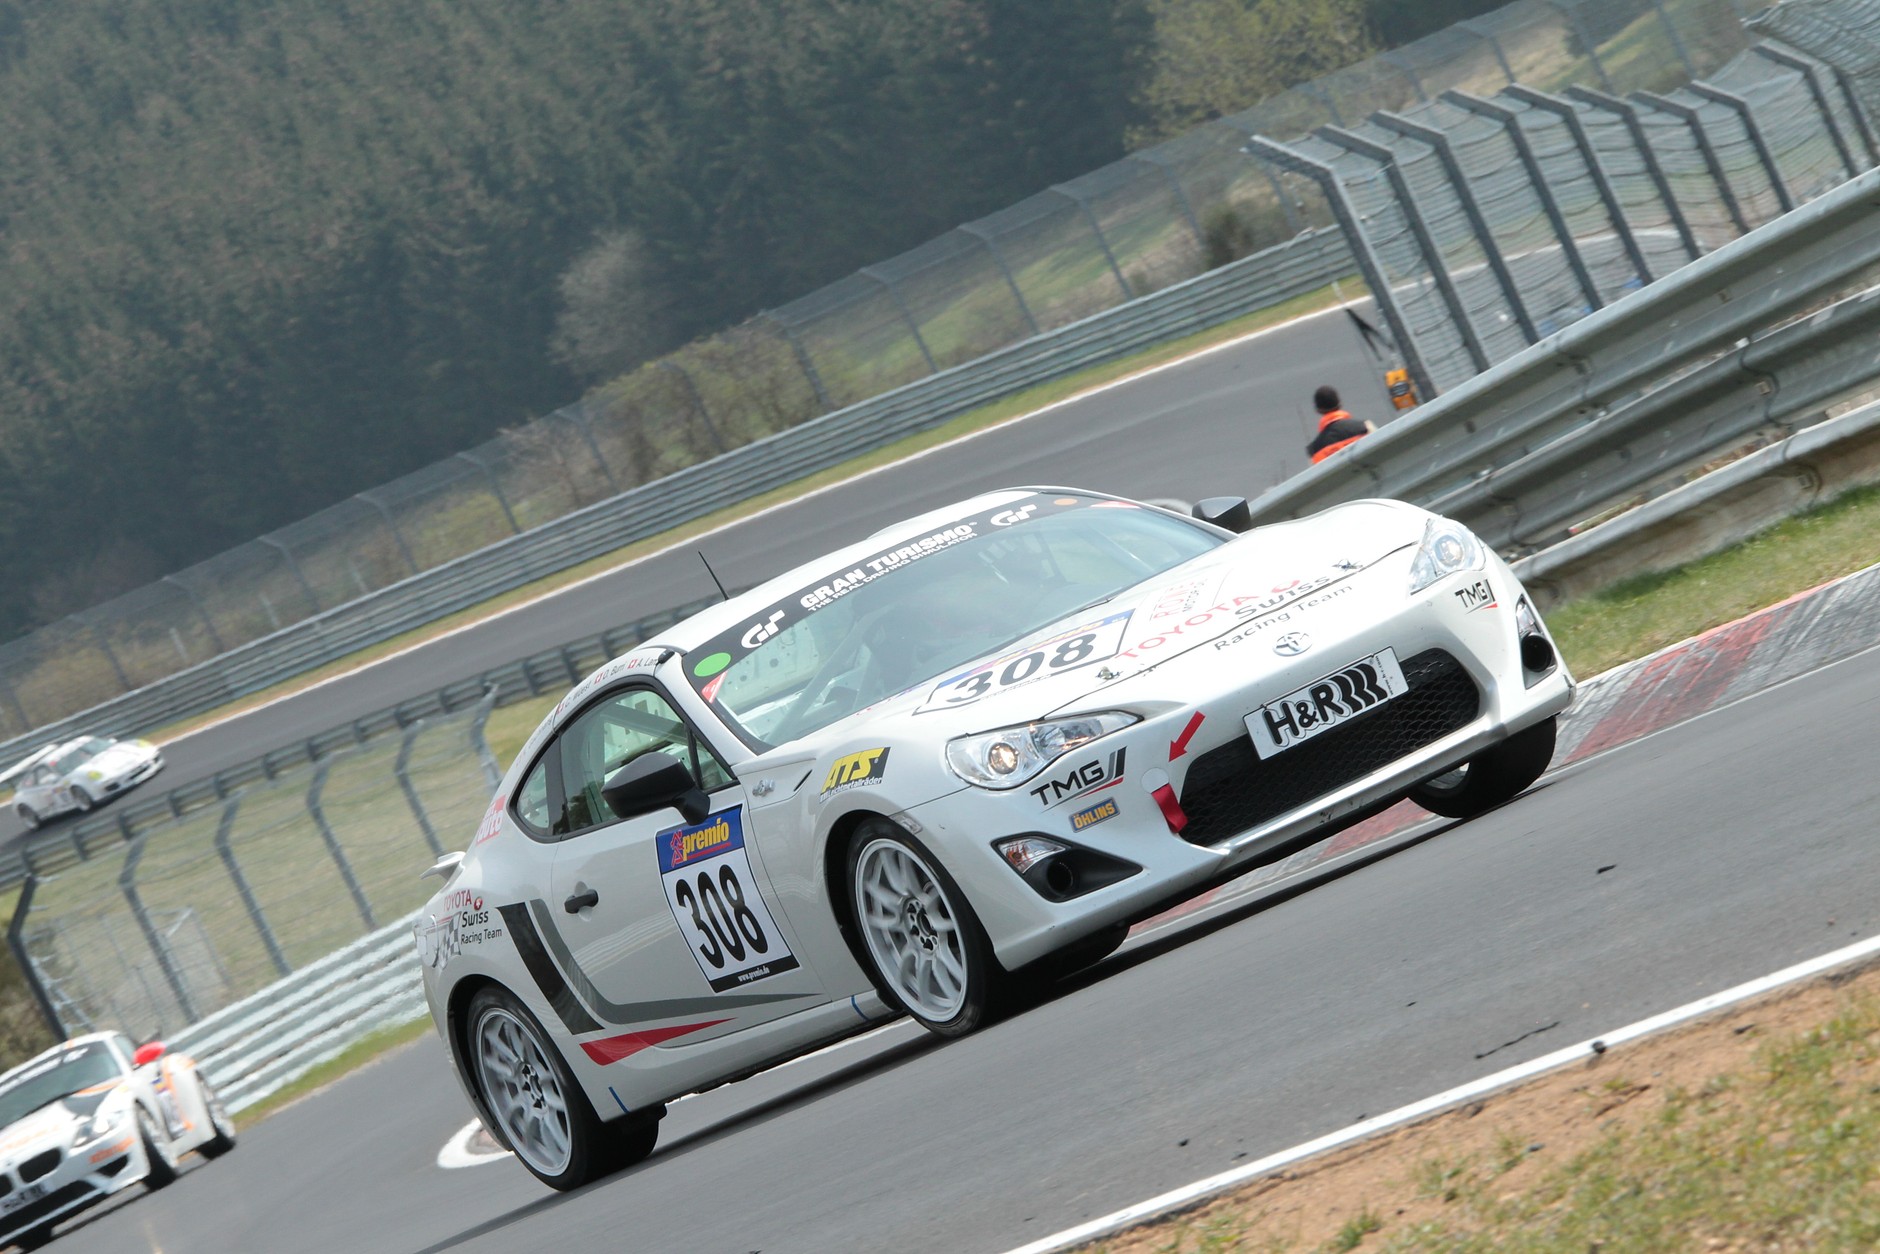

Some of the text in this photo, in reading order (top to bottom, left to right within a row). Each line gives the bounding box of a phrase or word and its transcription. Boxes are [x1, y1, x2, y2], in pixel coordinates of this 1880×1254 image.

[800, 524, 972, 609] GRAN TURISMO
[808, 532, 978, 612] THE REAL DRIVING SIMULATOR
[1214, 584, 1353, 651] Racing Team
[1235, 575, 1331, 619] Swiss
[1454, 581, 1489, 608] TMG
[1115, 594, 1260, 660] TOYOTA
[945, 632, 1097, 704] 308
[1263, 681, 1344, 746] H&R
[823, 747, 885, 794] ATS
[1030, 759, 1103, 806] TMG
[683, 817, 730, 861] premio
[1073, 803, 1116, 829] ÖHLINS
[443, 889, 472, 911] TOYOTA
[461, 910, 489, 928] Swiss
[675, 864, 769, 970] 308
[460, 928, 503, 945] Racing Team
